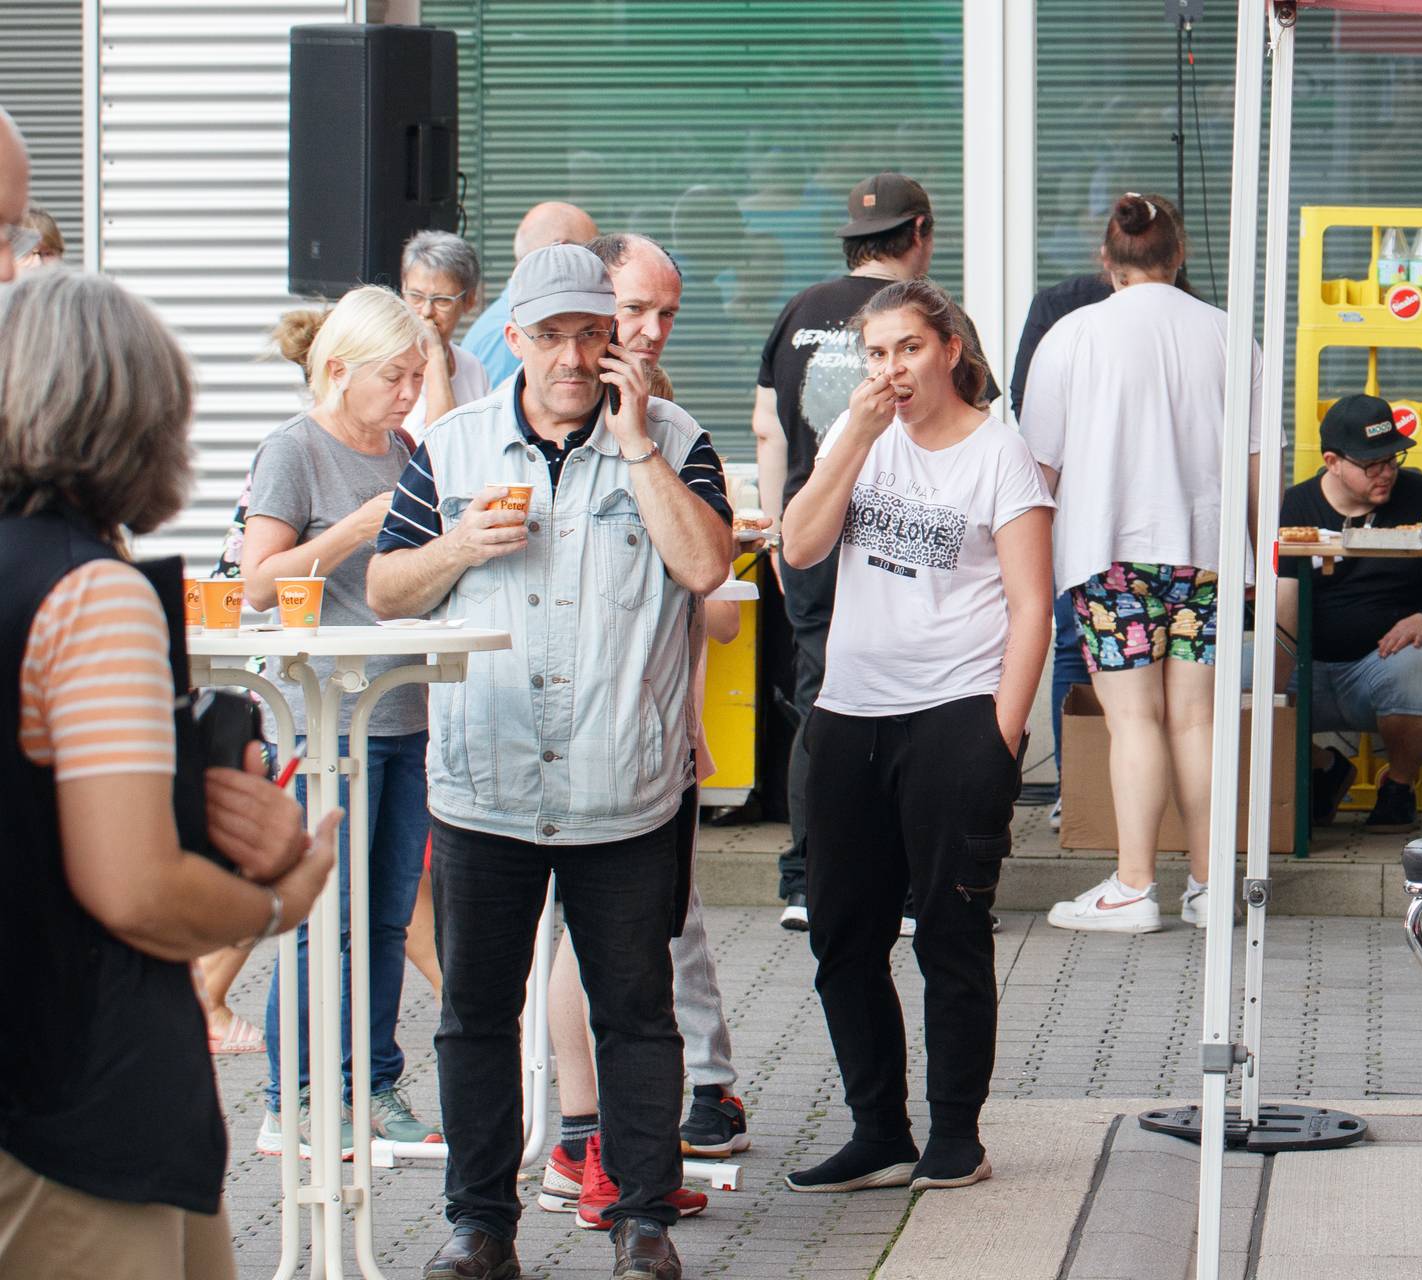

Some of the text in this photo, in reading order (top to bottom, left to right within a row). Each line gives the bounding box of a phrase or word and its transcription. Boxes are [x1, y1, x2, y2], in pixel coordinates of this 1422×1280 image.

[876, 471, 896, 487] DO
[501, 499, 525, 510] Peter
[850, 503, 949, 547] YOU LOVE
[280, 594, 305, 605] Peter
